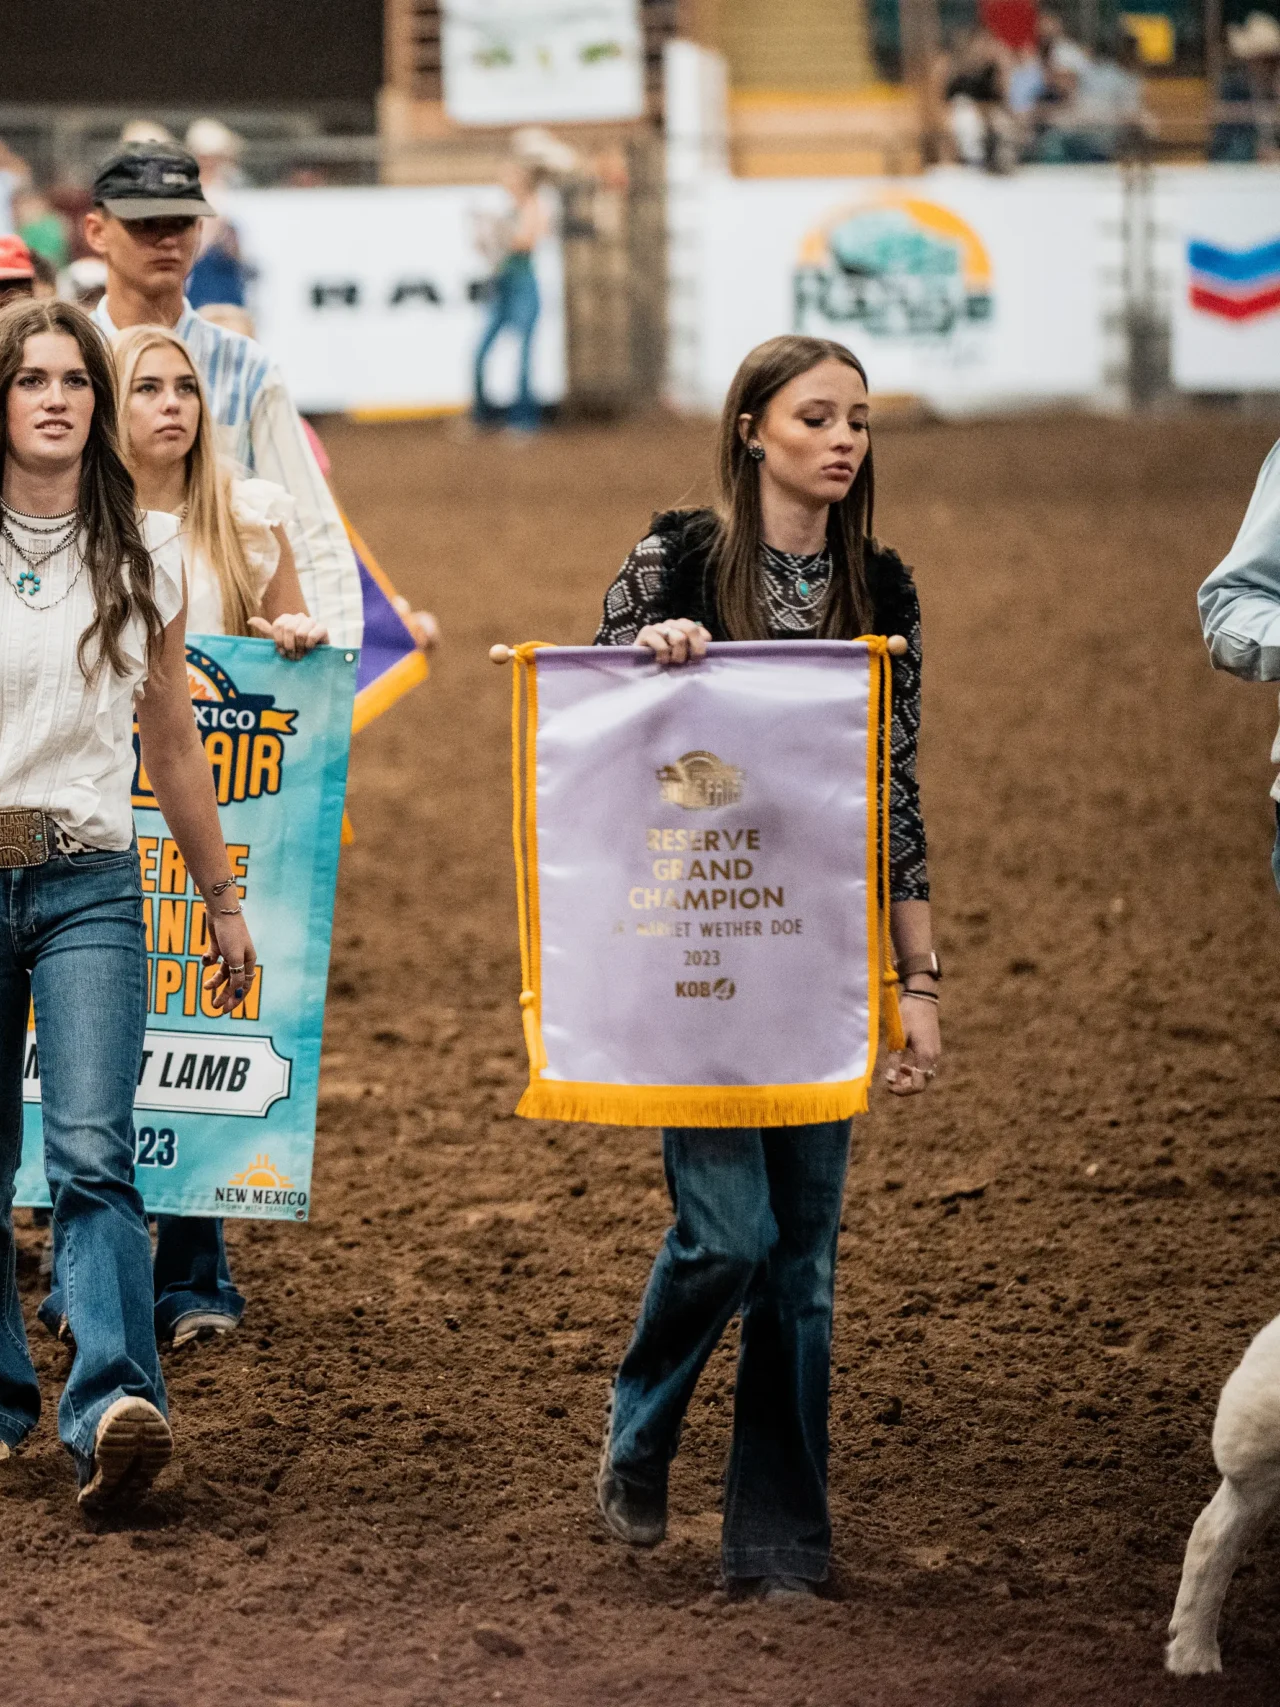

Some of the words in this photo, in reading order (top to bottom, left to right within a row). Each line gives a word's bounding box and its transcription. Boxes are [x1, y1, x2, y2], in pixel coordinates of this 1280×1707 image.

[194, 704, 256, 730] XICO
[204, 730, 282, 804] AIR
[0, 813, 32, 828] CLASSIC
[647, 829, 761, 851] RESERVE
[652, 858, 753, 881] GRAND
[629, 886, 785, 910] CHAMPION
[699, 921, 763, 937] WETHER
[771, 919, 804, 935] DOE
[684, 950, 721, 966] 2023
[158, 1051, 251, 1092] LAMB
[135, 1126, 179, 1167] 23
[215, 1187, 247, 1203] NEW
[253, 1189, 307, 1206] MEXICO
